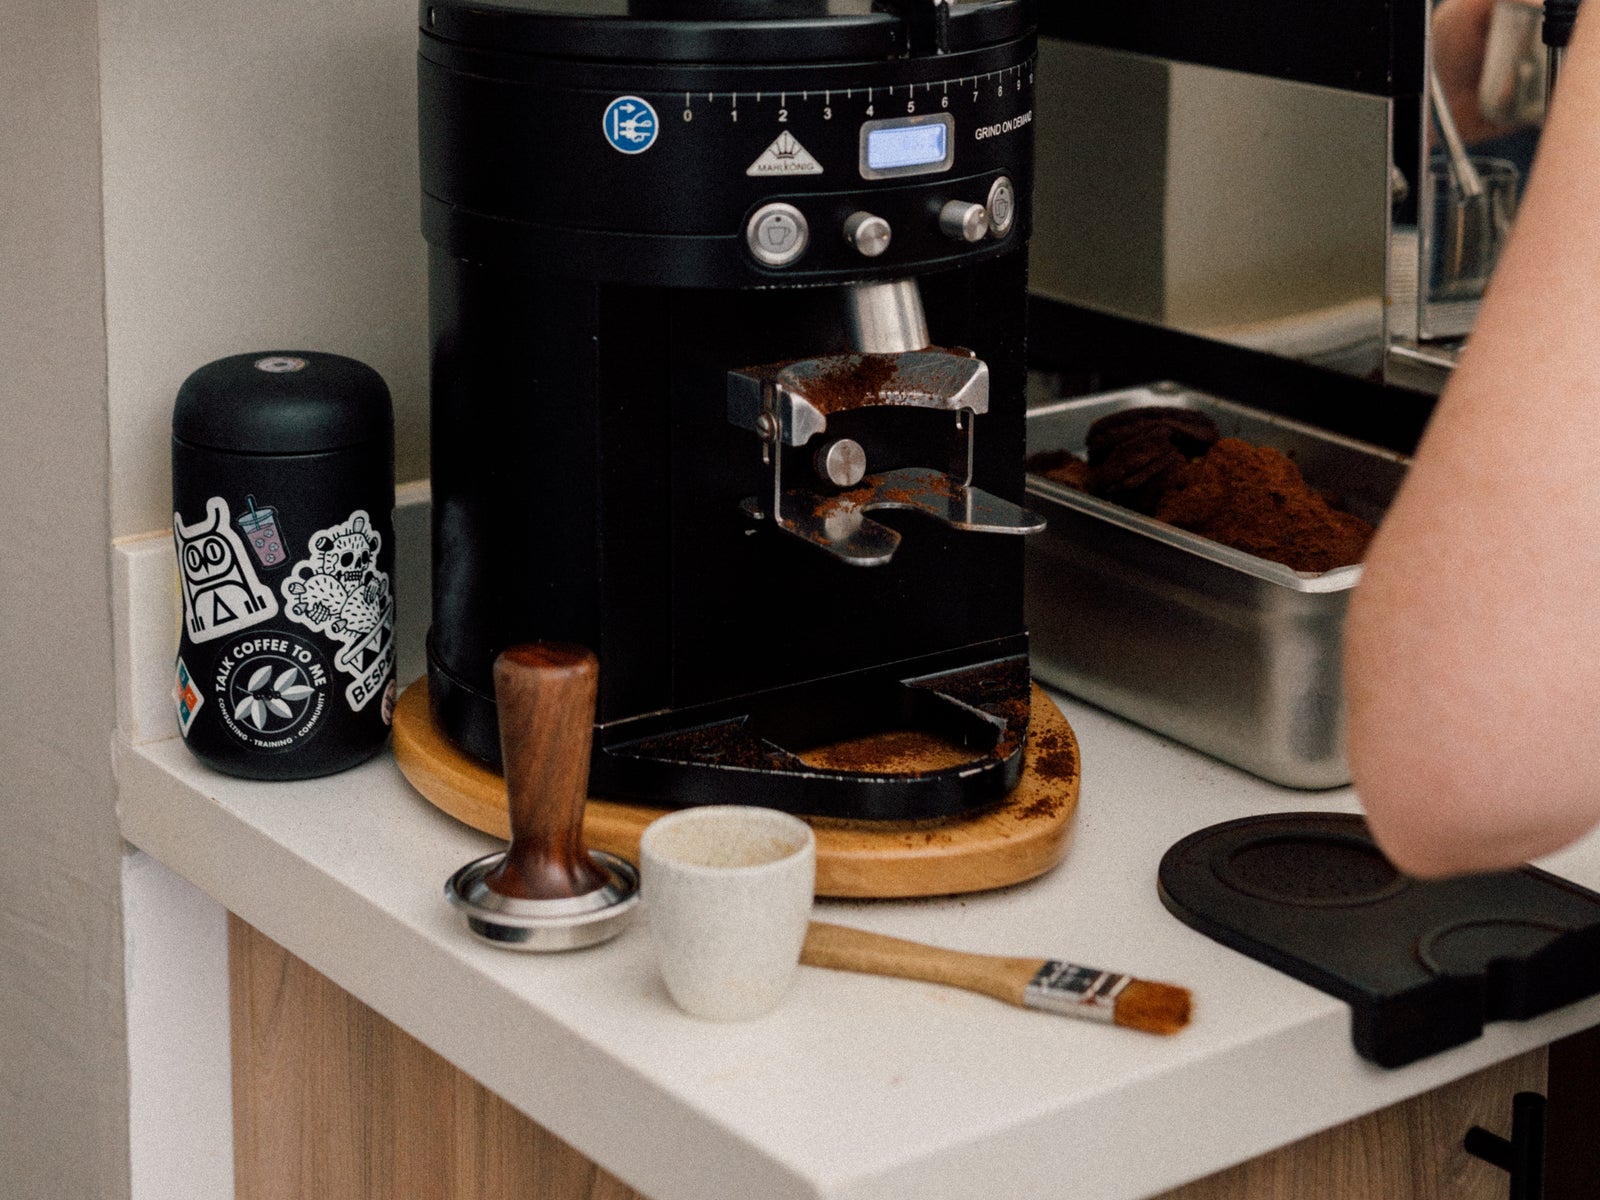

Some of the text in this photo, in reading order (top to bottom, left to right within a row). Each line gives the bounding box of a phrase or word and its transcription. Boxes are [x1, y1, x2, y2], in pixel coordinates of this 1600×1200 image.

[683, 109, 692, 122] 0
[731, 110, 738, 122] 1
[778, 109, 788, 122] 2
[823, 107, 832, 120] 3
[866, 105, 874, 117] 4
[907, 101, 914, 113] 5
[941, 96, 949, 108] 6
[973, 91, 979, 103] 7
[997, 85, 1003, 97] 8
[1016, 79, 1021, 90] 9
[975, 123, 1002, 140] GRIND
[1002, 119, 1013, 133] ON
[215, 638, 327, 692] TALK COFFEE TO ME
[218, 692, 326, 748] CONSULTING TRAINING COMMUNITY
